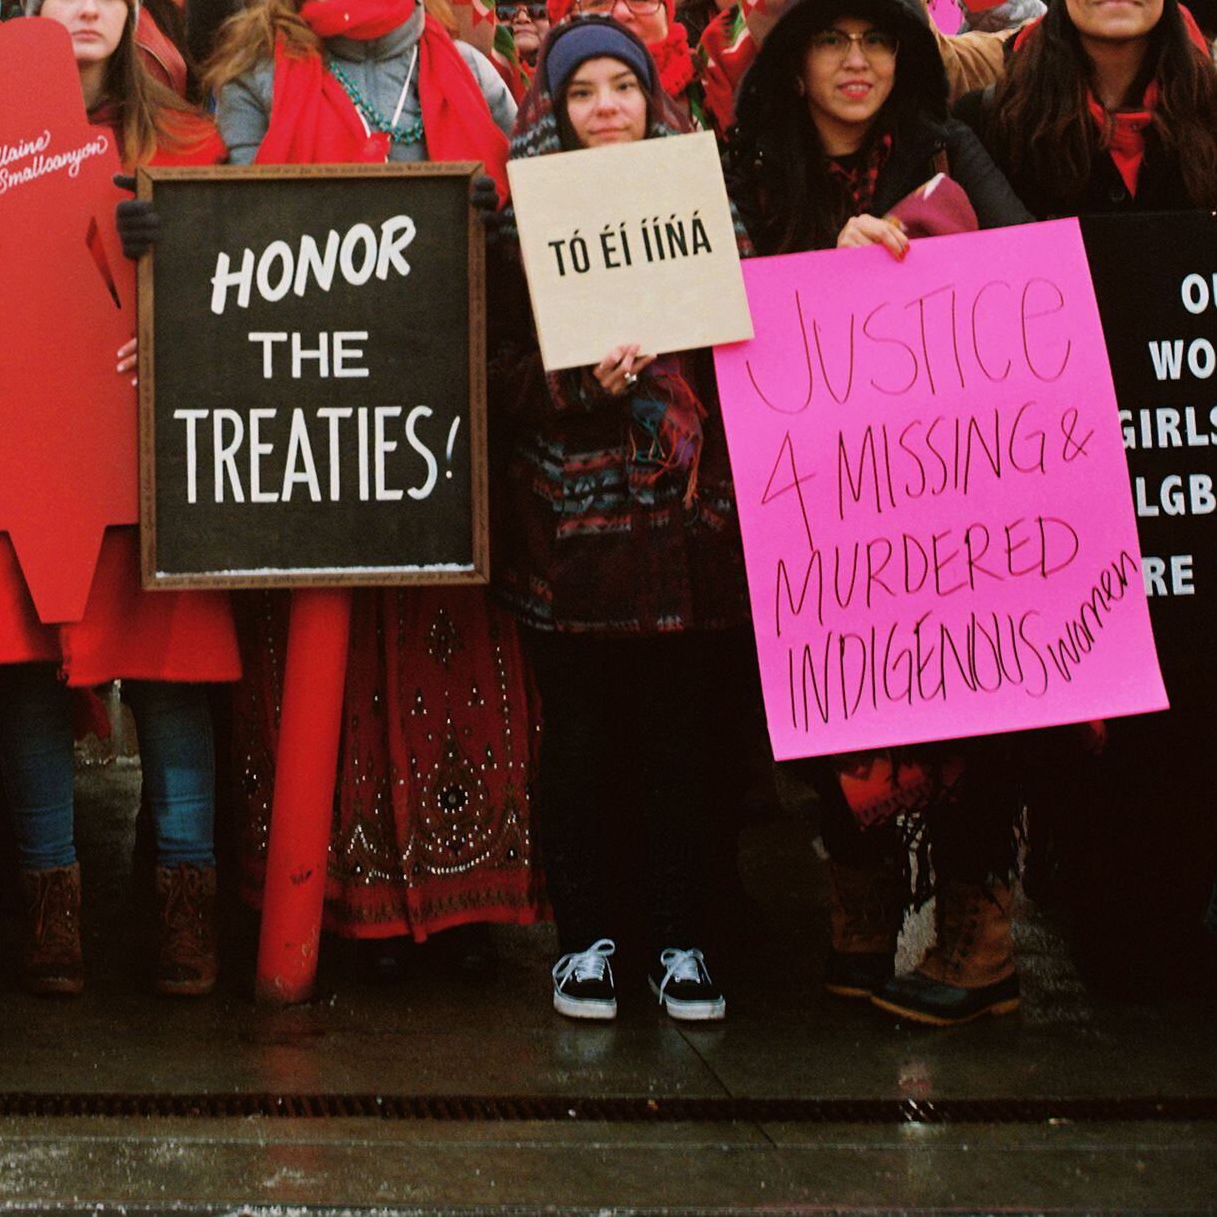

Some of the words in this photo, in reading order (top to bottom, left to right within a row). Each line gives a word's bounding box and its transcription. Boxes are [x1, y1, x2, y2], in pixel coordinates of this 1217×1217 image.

[211, 214, 416, 314] HONOR
[548, 229, 590, 277] TÓ
[599, 222, 632, 269] ÉÍ
[248, 331, 370, 379] THE
[174, 405, 461, 504] TREATIES!
[761, 430, 816, 550] 4
[837, 402, 1048, 521] MISSING
[1061, 408, 1096, 463] &
[775, 517, 1079, 638] MURDERED
[788, 609, 1049, 732] INDIGENOUS
